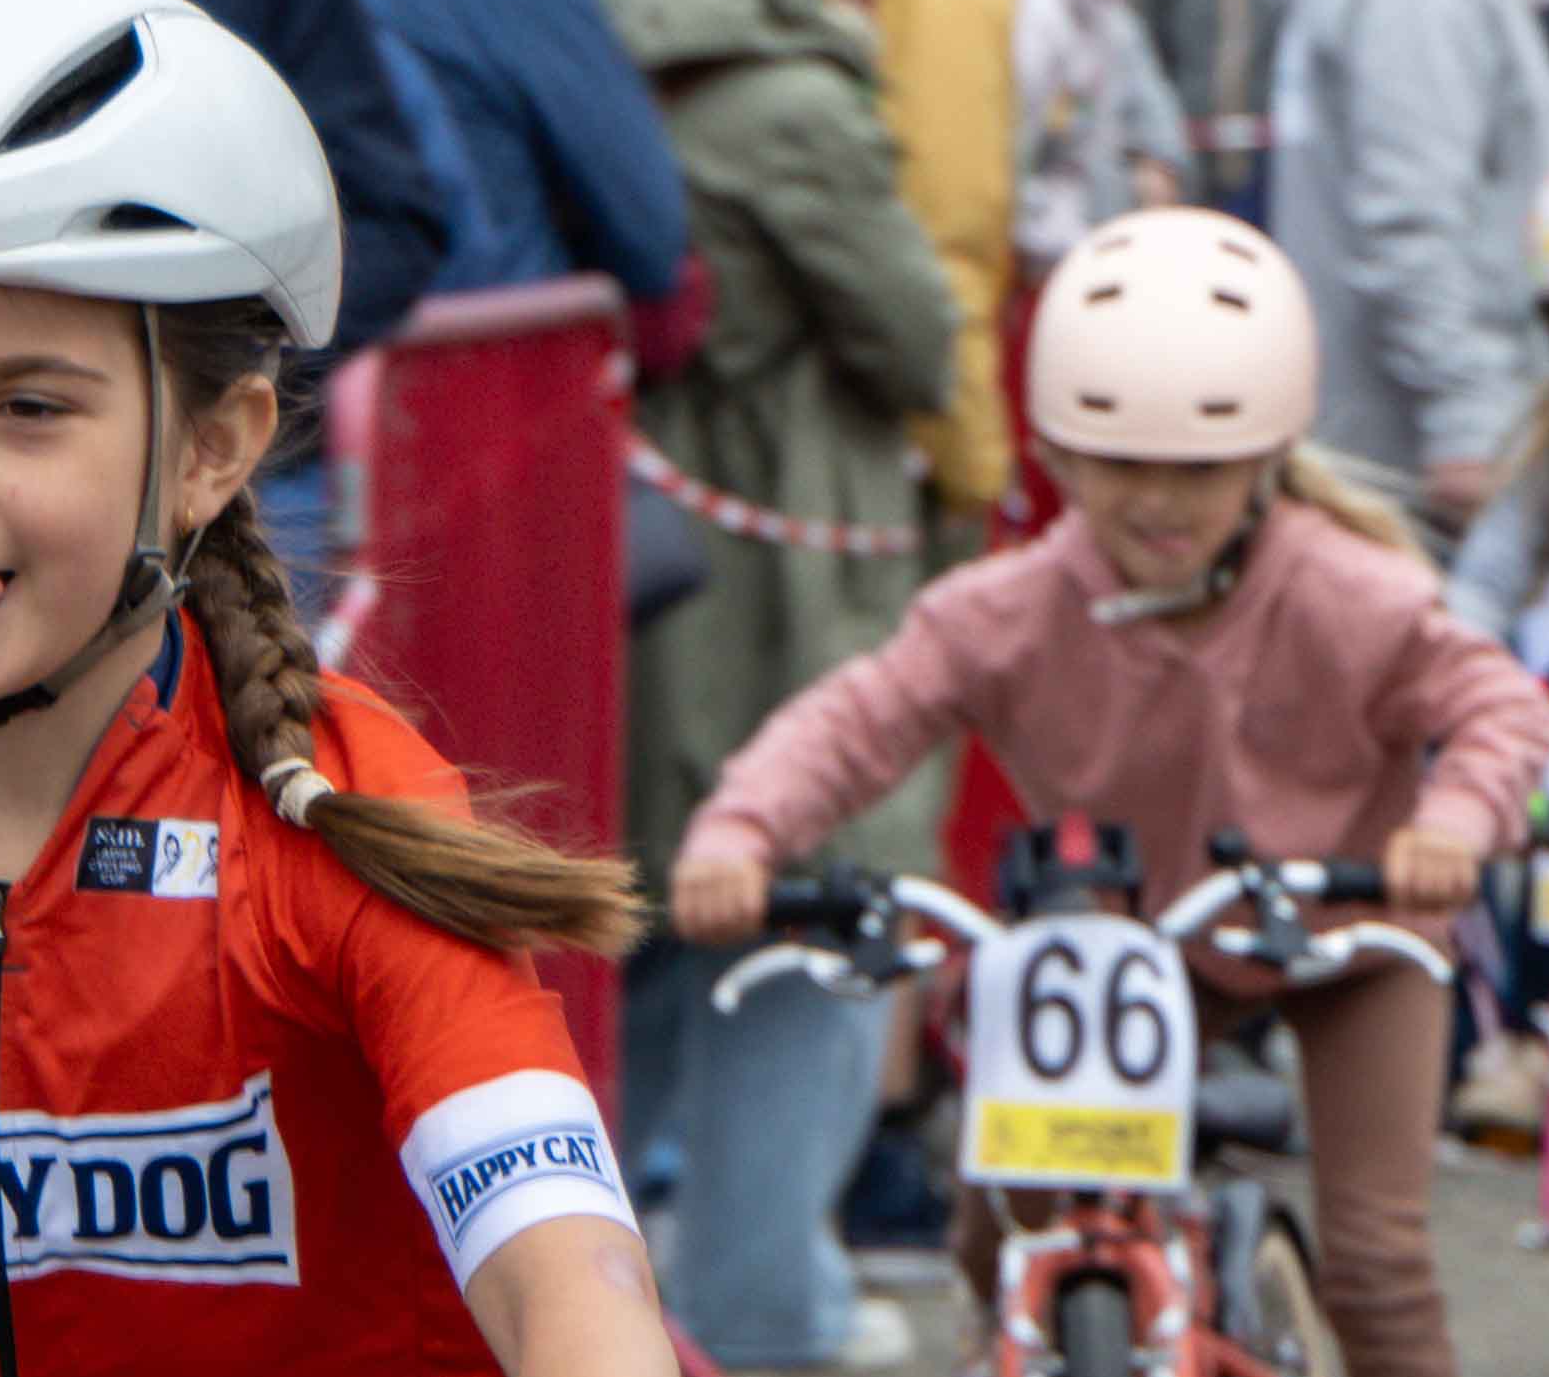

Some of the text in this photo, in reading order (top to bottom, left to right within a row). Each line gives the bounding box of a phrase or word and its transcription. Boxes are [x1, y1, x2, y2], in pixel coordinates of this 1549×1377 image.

[1017, 932, 1171, 1087] 66
[68, 1130, 274, 1241] DOG
[438, 1135, 603, 1226] HAPPY CAT
